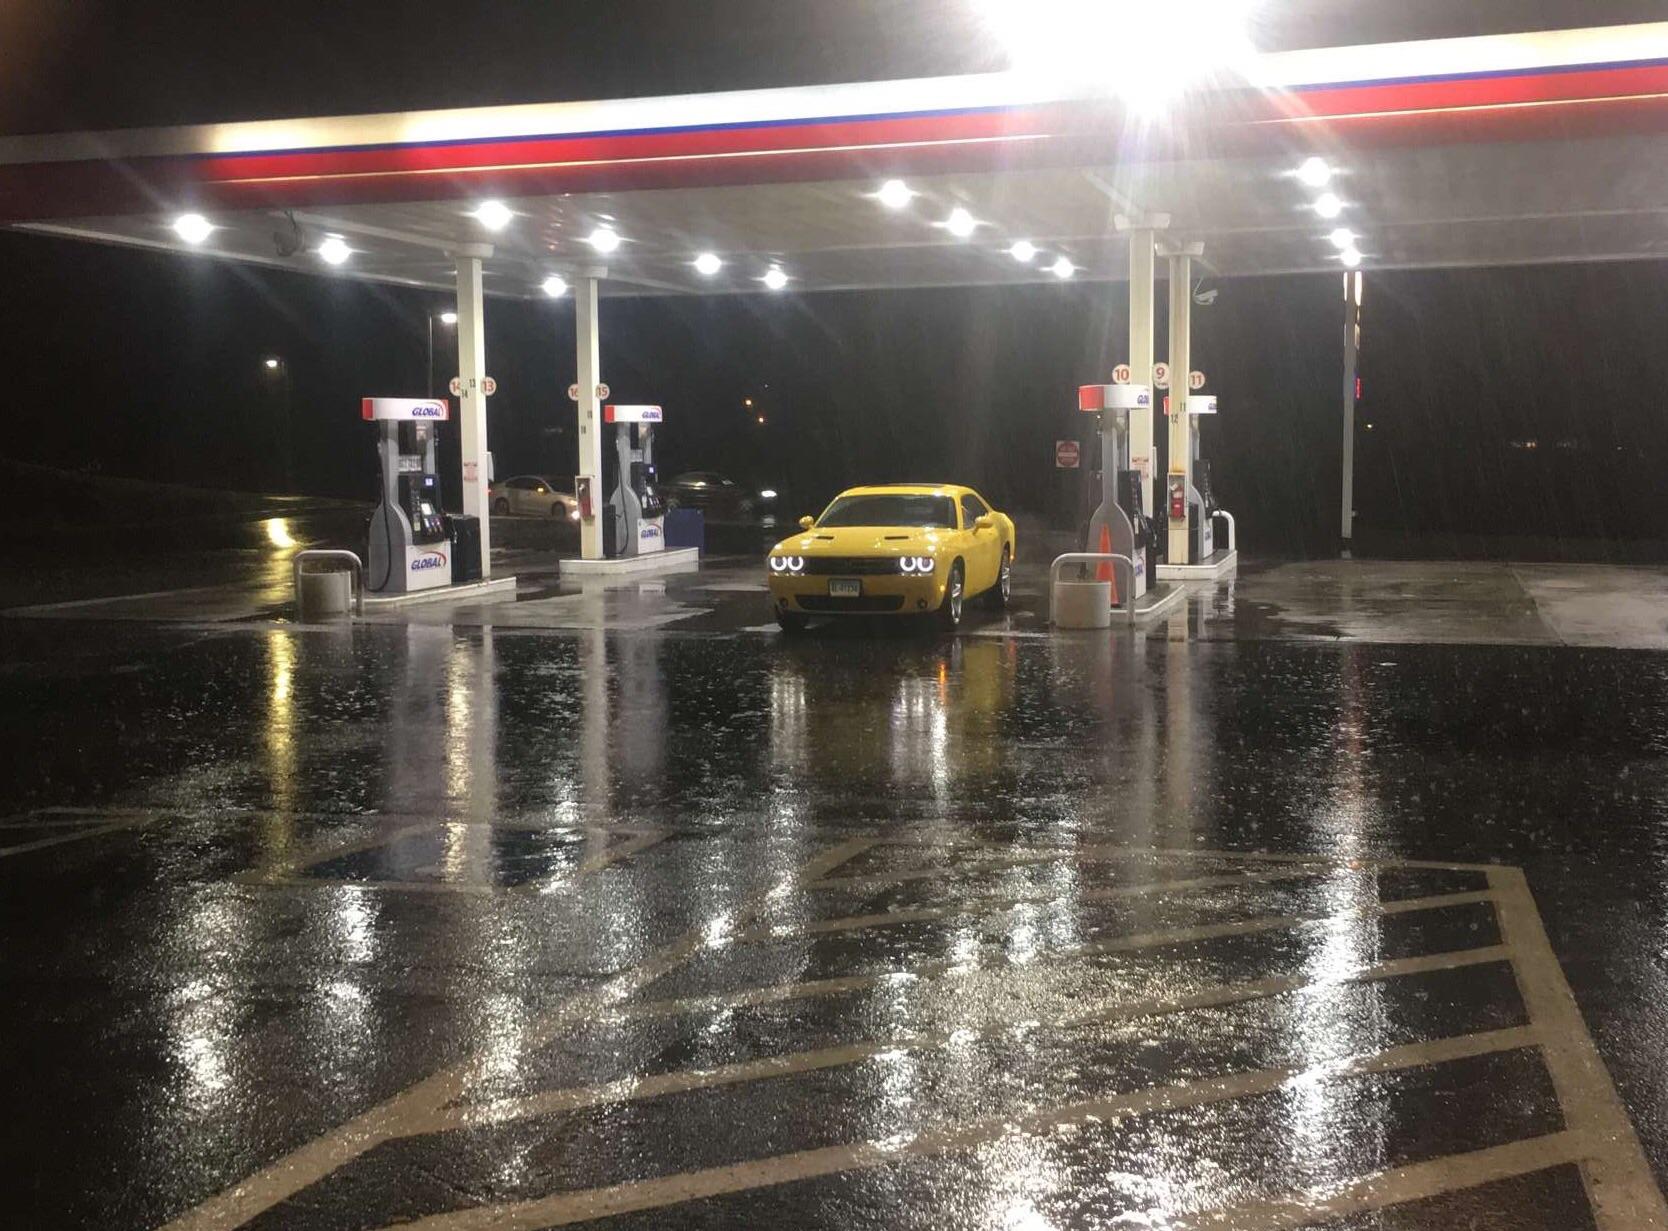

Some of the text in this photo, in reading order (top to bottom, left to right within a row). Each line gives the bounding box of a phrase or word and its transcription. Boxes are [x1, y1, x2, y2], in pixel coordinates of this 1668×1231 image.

[1115, 368, 1130, 381] 10
[1156, 366, 1165, 379] 9
[482, 380, 494, 392] 13
[1191, 374, 1202, 386] 11
[597, 386, 608, 397] 15
[411, 406, 441, 417] GLOBAL
[411, 557, 442, 571] GLOBAL
